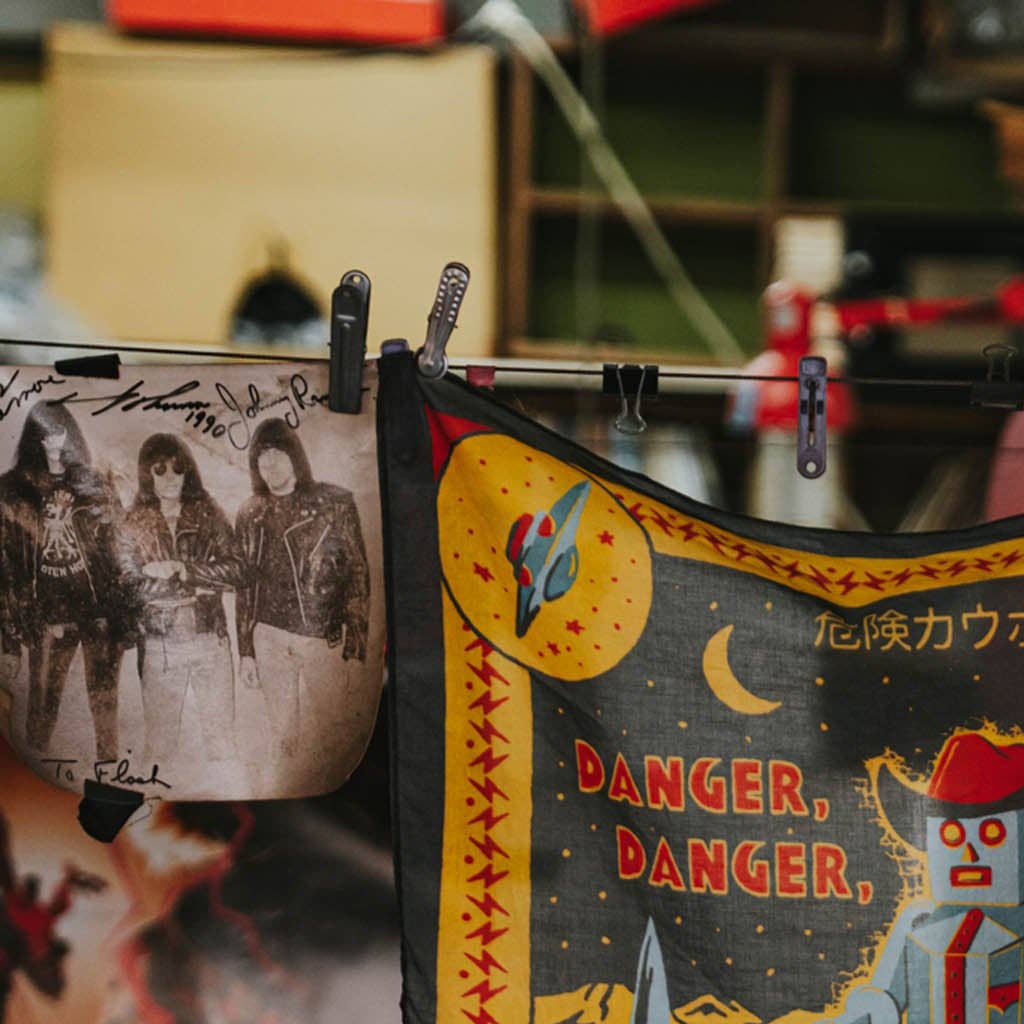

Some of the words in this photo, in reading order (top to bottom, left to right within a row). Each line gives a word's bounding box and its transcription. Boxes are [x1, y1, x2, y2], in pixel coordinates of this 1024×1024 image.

[185, 411, 226, 438] 1990
[575, 738, 830, 822] DANGER,
[616, 825, 873, 905] DANGER,
